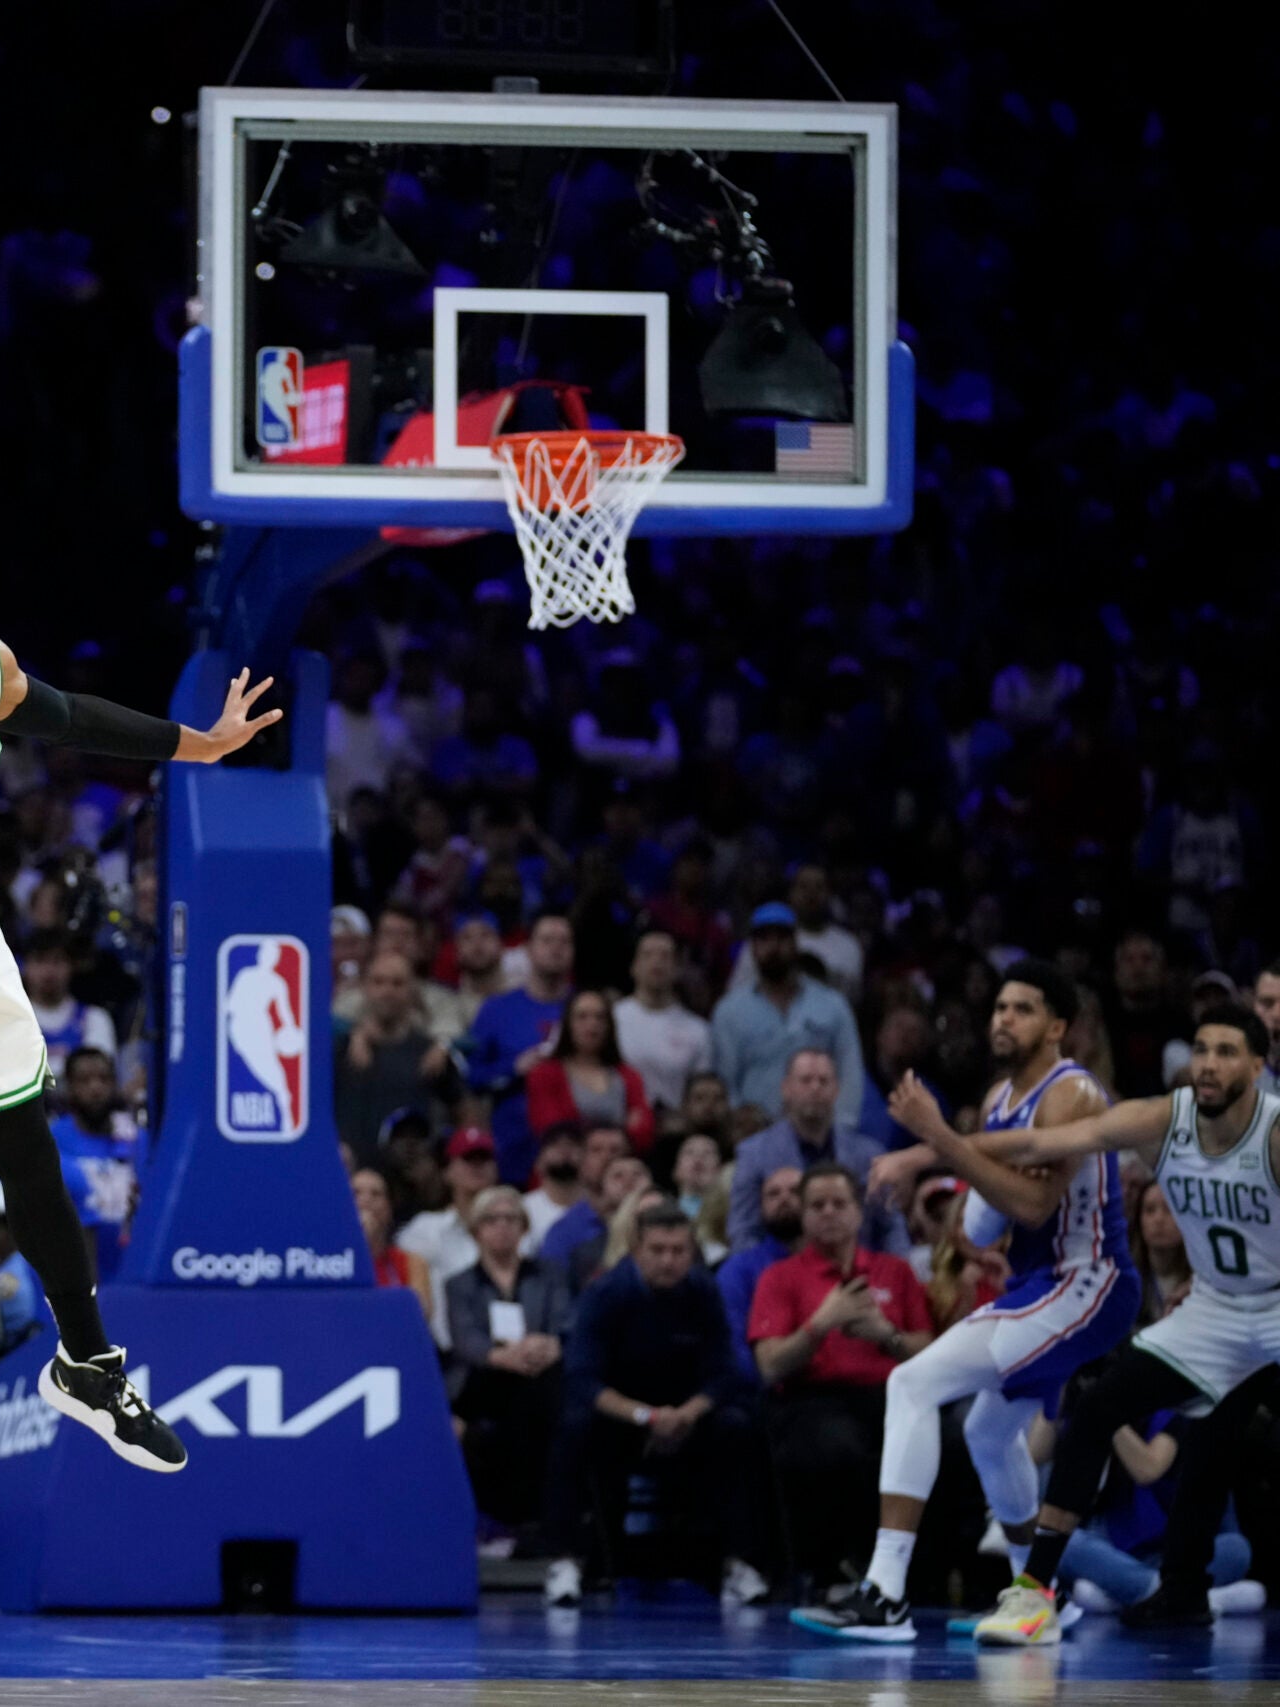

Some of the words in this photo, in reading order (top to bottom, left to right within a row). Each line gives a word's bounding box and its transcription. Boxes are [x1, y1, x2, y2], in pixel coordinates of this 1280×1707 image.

[1167, 1175, 1271, 1225] CELTICS
[172, 1246, 283, 1287] Google
[285, 1246, 355, 1280] Pixel
[1207, 1225, 1249, 1277] 0
